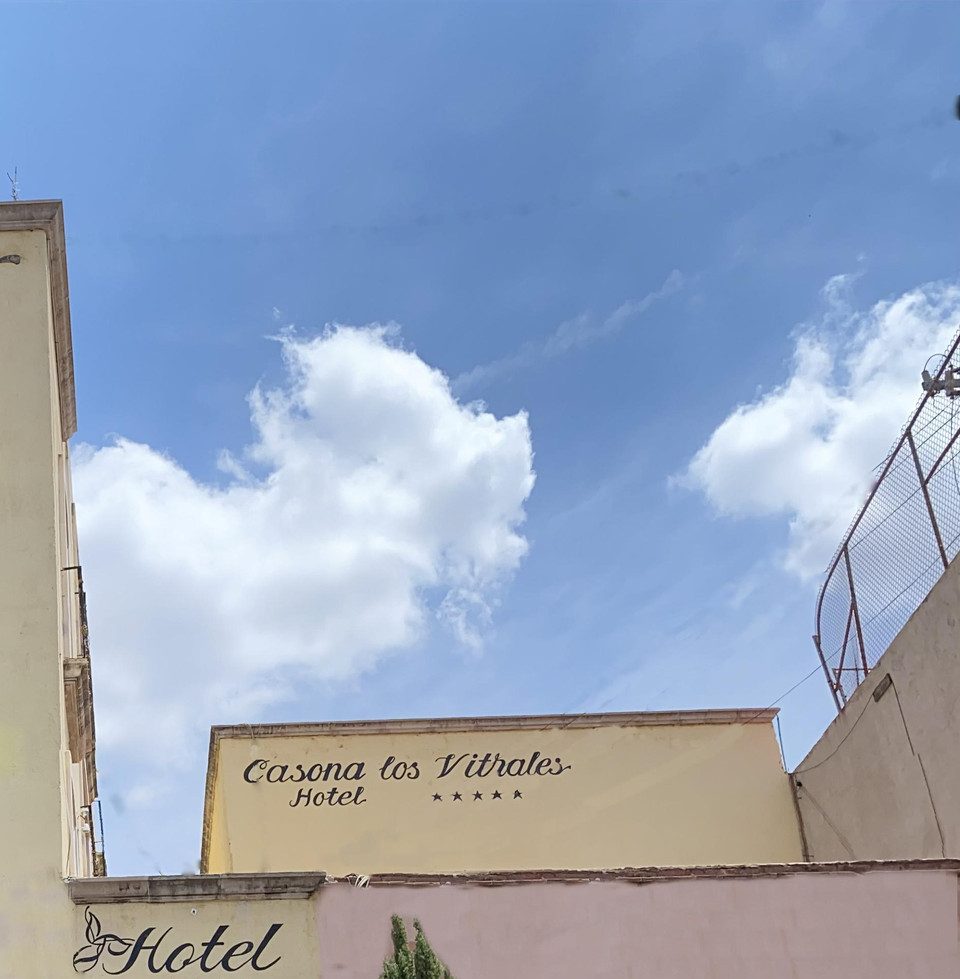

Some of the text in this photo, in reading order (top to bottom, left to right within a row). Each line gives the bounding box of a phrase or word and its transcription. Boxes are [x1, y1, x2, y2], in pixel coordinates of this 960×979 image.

[243, 751, 571, 784] Casona los Vitrales
[289, 786, 366, 808] Hotel
[102, 923, 284, 975] Hotel
